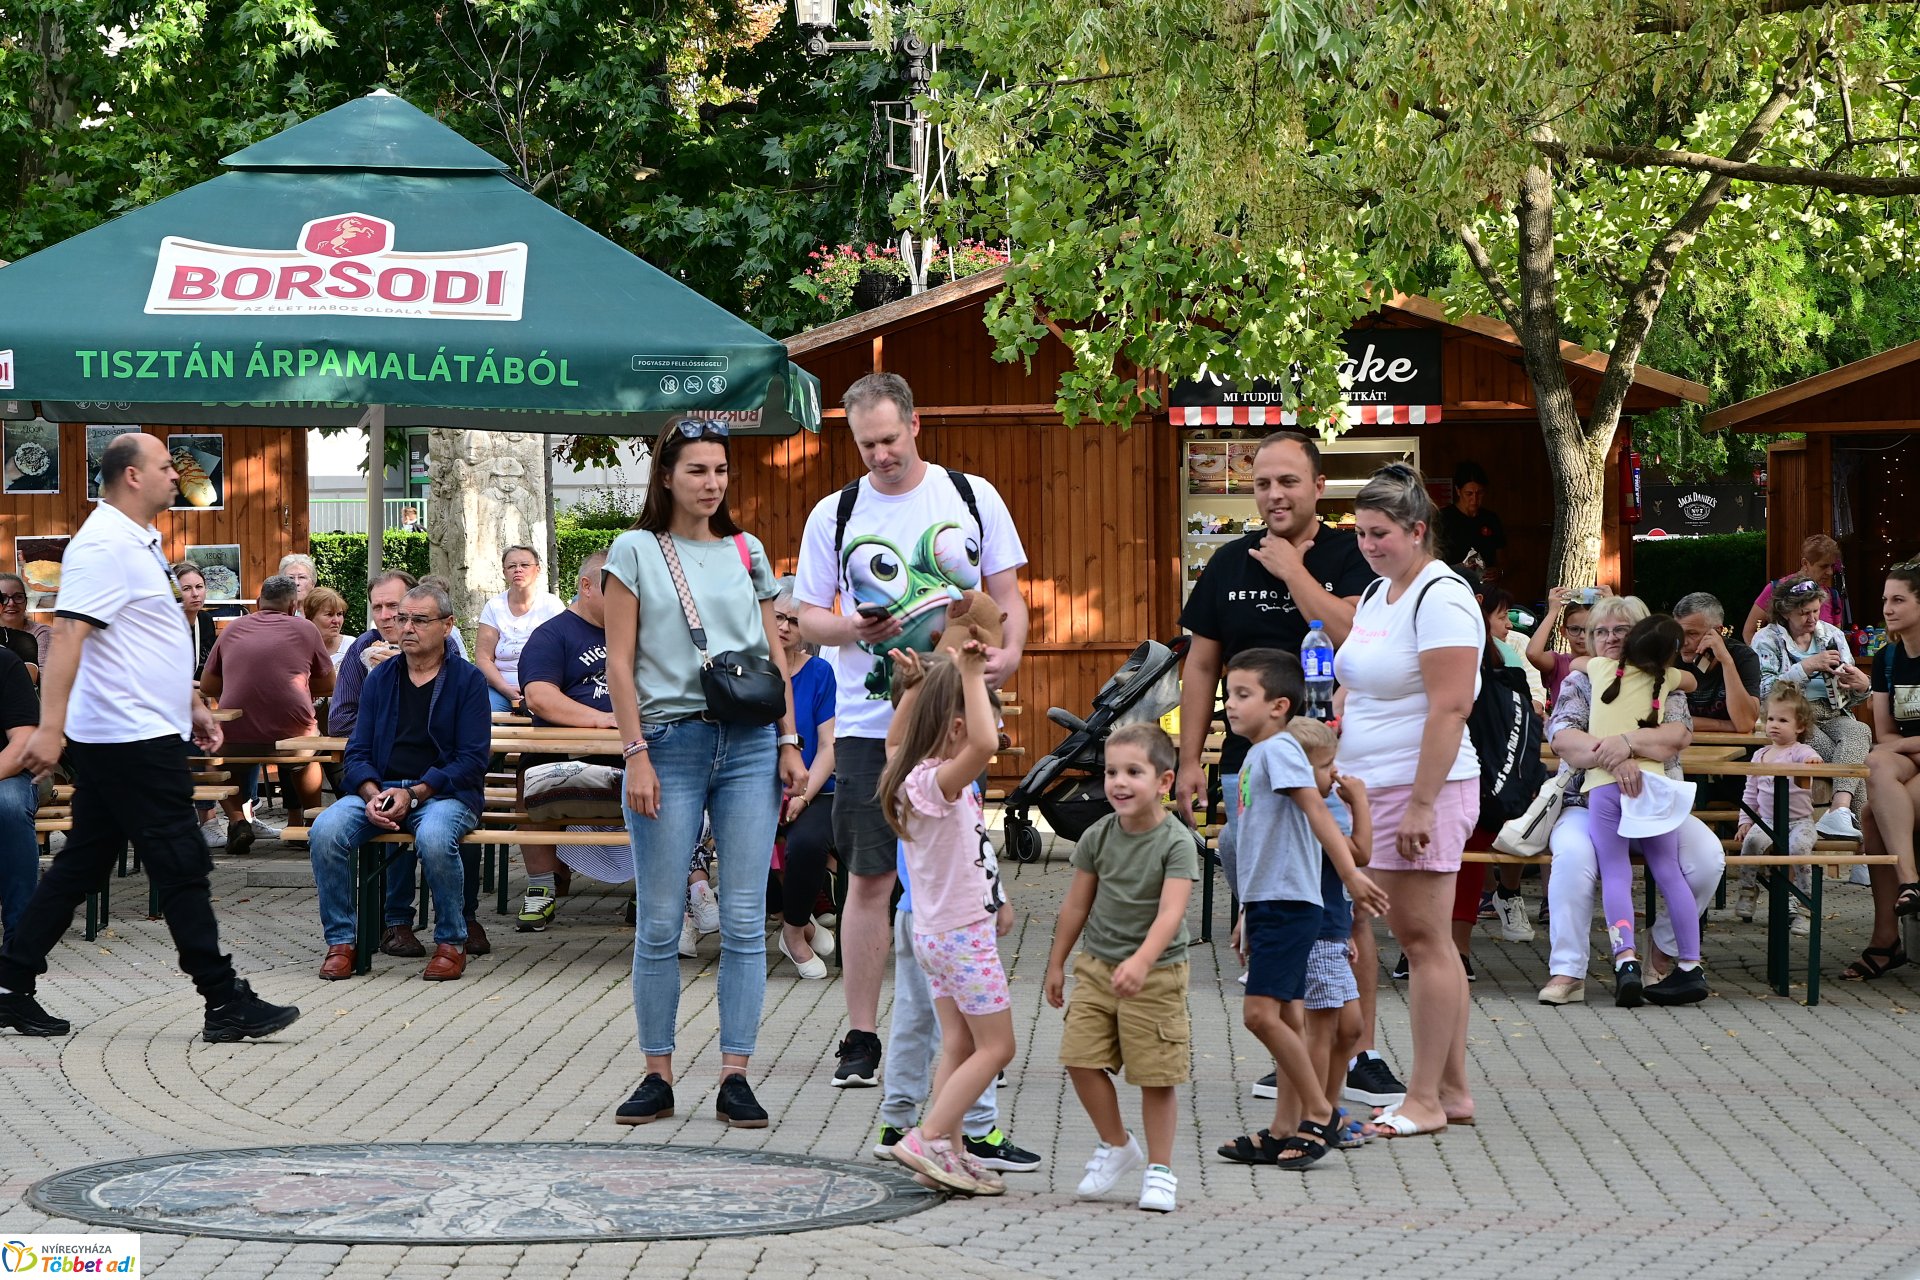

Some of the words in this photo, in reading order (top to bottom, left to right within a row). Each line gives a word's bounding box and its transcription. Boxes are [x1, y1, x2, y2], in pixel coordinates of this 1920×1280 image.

[167, 260, 508, 307] BORSODI
[267, 304, 303, 312] ÉLET
[308, 304, 359, 312] HABOS
[364, 306, 423, 315] OLDALA
[75, 341, 234, 378] TISZTÁN
[245, 341, 579, 387] ÁRPAMALÁTÁBÓL
[1223, 392, 1239, 402] MI
[1240, 392, 1285, 404] TUDJU
[1677, 494, 1693, 508] JACK
[1692, 491, 1718, 508] DANIEL'S
[1228, 590, 1278, 601] RETRO
